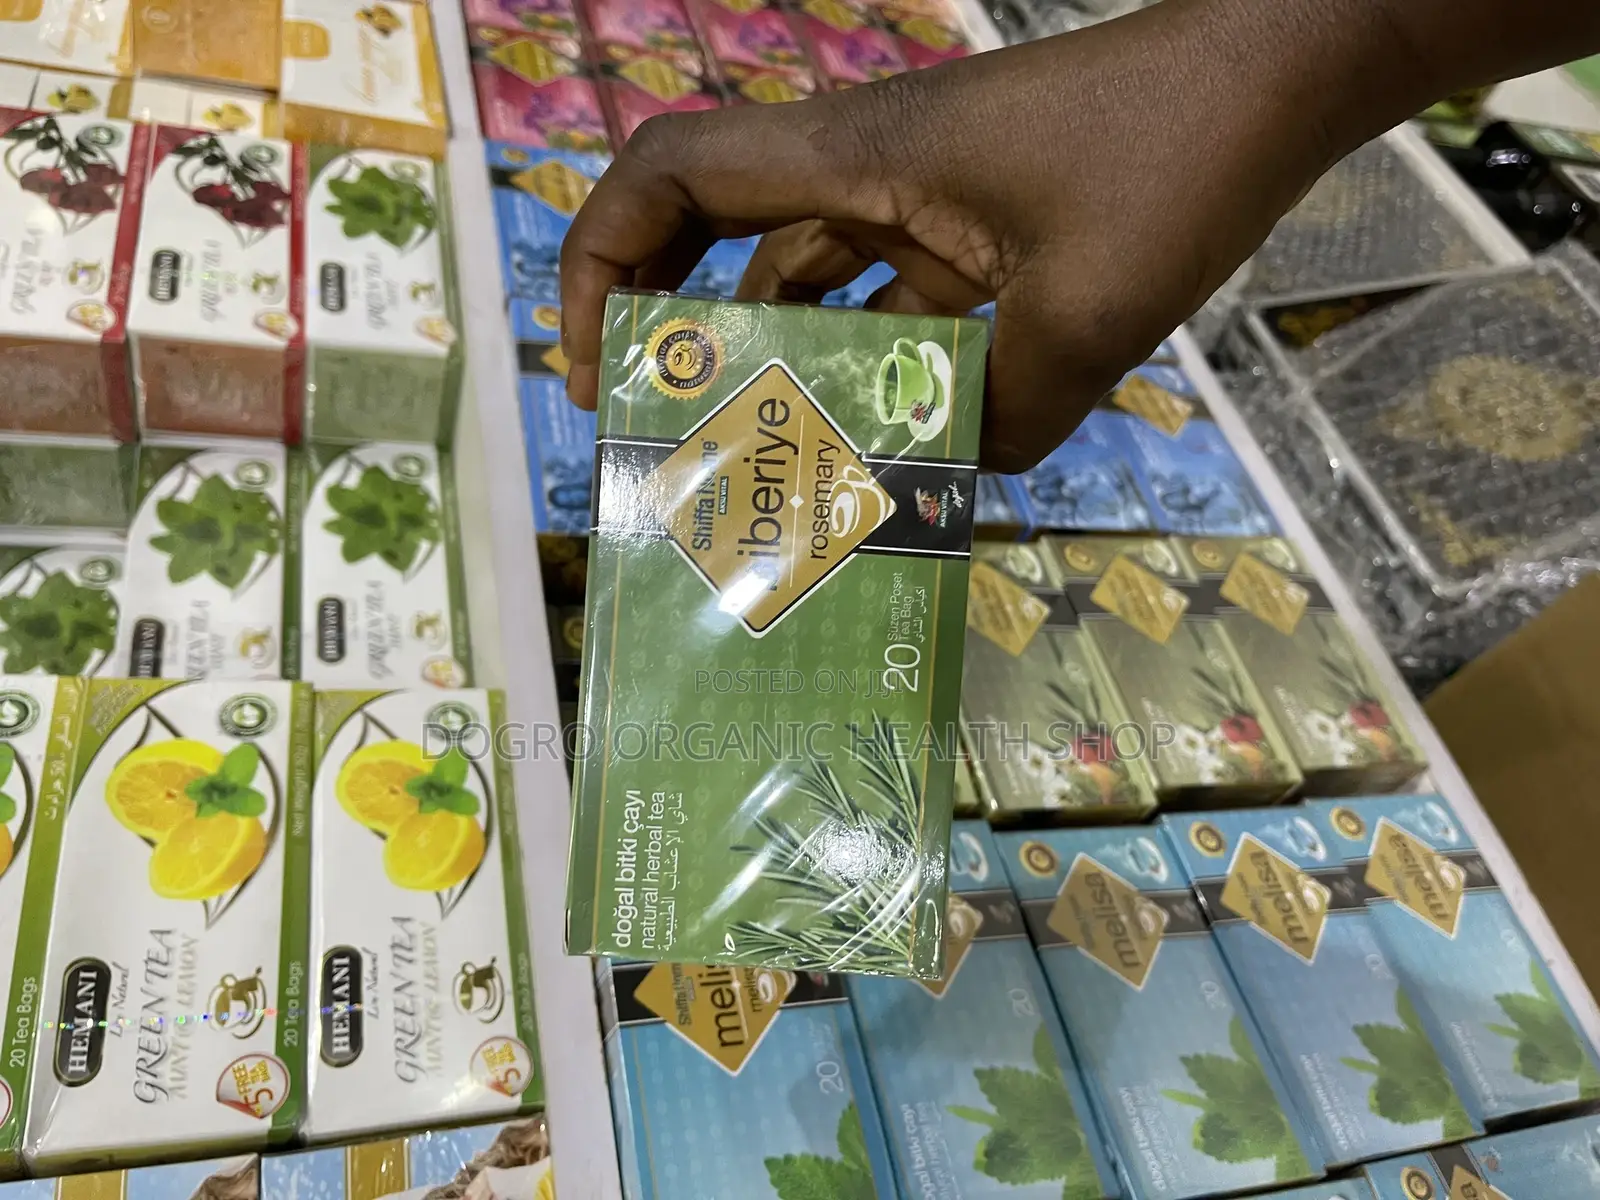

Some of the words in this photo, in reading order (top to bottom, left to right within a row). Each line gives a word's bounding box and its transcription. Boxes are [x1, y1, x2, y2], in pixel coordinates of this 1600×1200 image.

[699, 440, 719, 496] Hme
[720, 477, 729, 496] VITAL
[692, 498, 715, 551] Shiffa
[719, 497, 728, 515] AKSU
[810, 439, 841, 560] rosemary
[890, 572, 904, 604] Poşet
[902, 596, 915, 613] Bag
[888, 607, 901, 642] Süzen
[900, 615, 911, 641] Tea
[883, 643, 921, 693] 20
[623, 789, 646, 835] çayı
[647, 791, 666, 821] tea
[667, 791, 689, 826] شاي
[614, 838, 639, 883] bitki
[642, 825, 663, 883] herbal
[1390, 834, 1451, 920] melisa
[611, 886, 639, 948] doğal
[640, 886, 659, 949] natural
[1085, 872, 1141, 968] melisa
[1250, 850, 1309, 944] melisa
[144, 928, 175, 986] TEA
[389, 915, 416, 969] TEA
[420, 922, 442, 993] LEMON
[16, 976, 38, 1013] Bags
[177, 933, 200, 1007] LEMON
[285, 961, 304, 997] Bags
[68, 970, 98, 1073] HEMANI
[284, 999, 301, 1028] Tea
[332, 956, 350, 1055] HEMANI
[390, 971, 427, 1084] GREEN
[698, 965, 746, 1048] meli
[12, 1017, 31, 1046] Tea
[133, 986, 170, 1104] GREEN
[283, 1028, 299, 1048] 20
[8, 1047, 27, 1068] 20
[815, 1060, 844, 1095] 20
